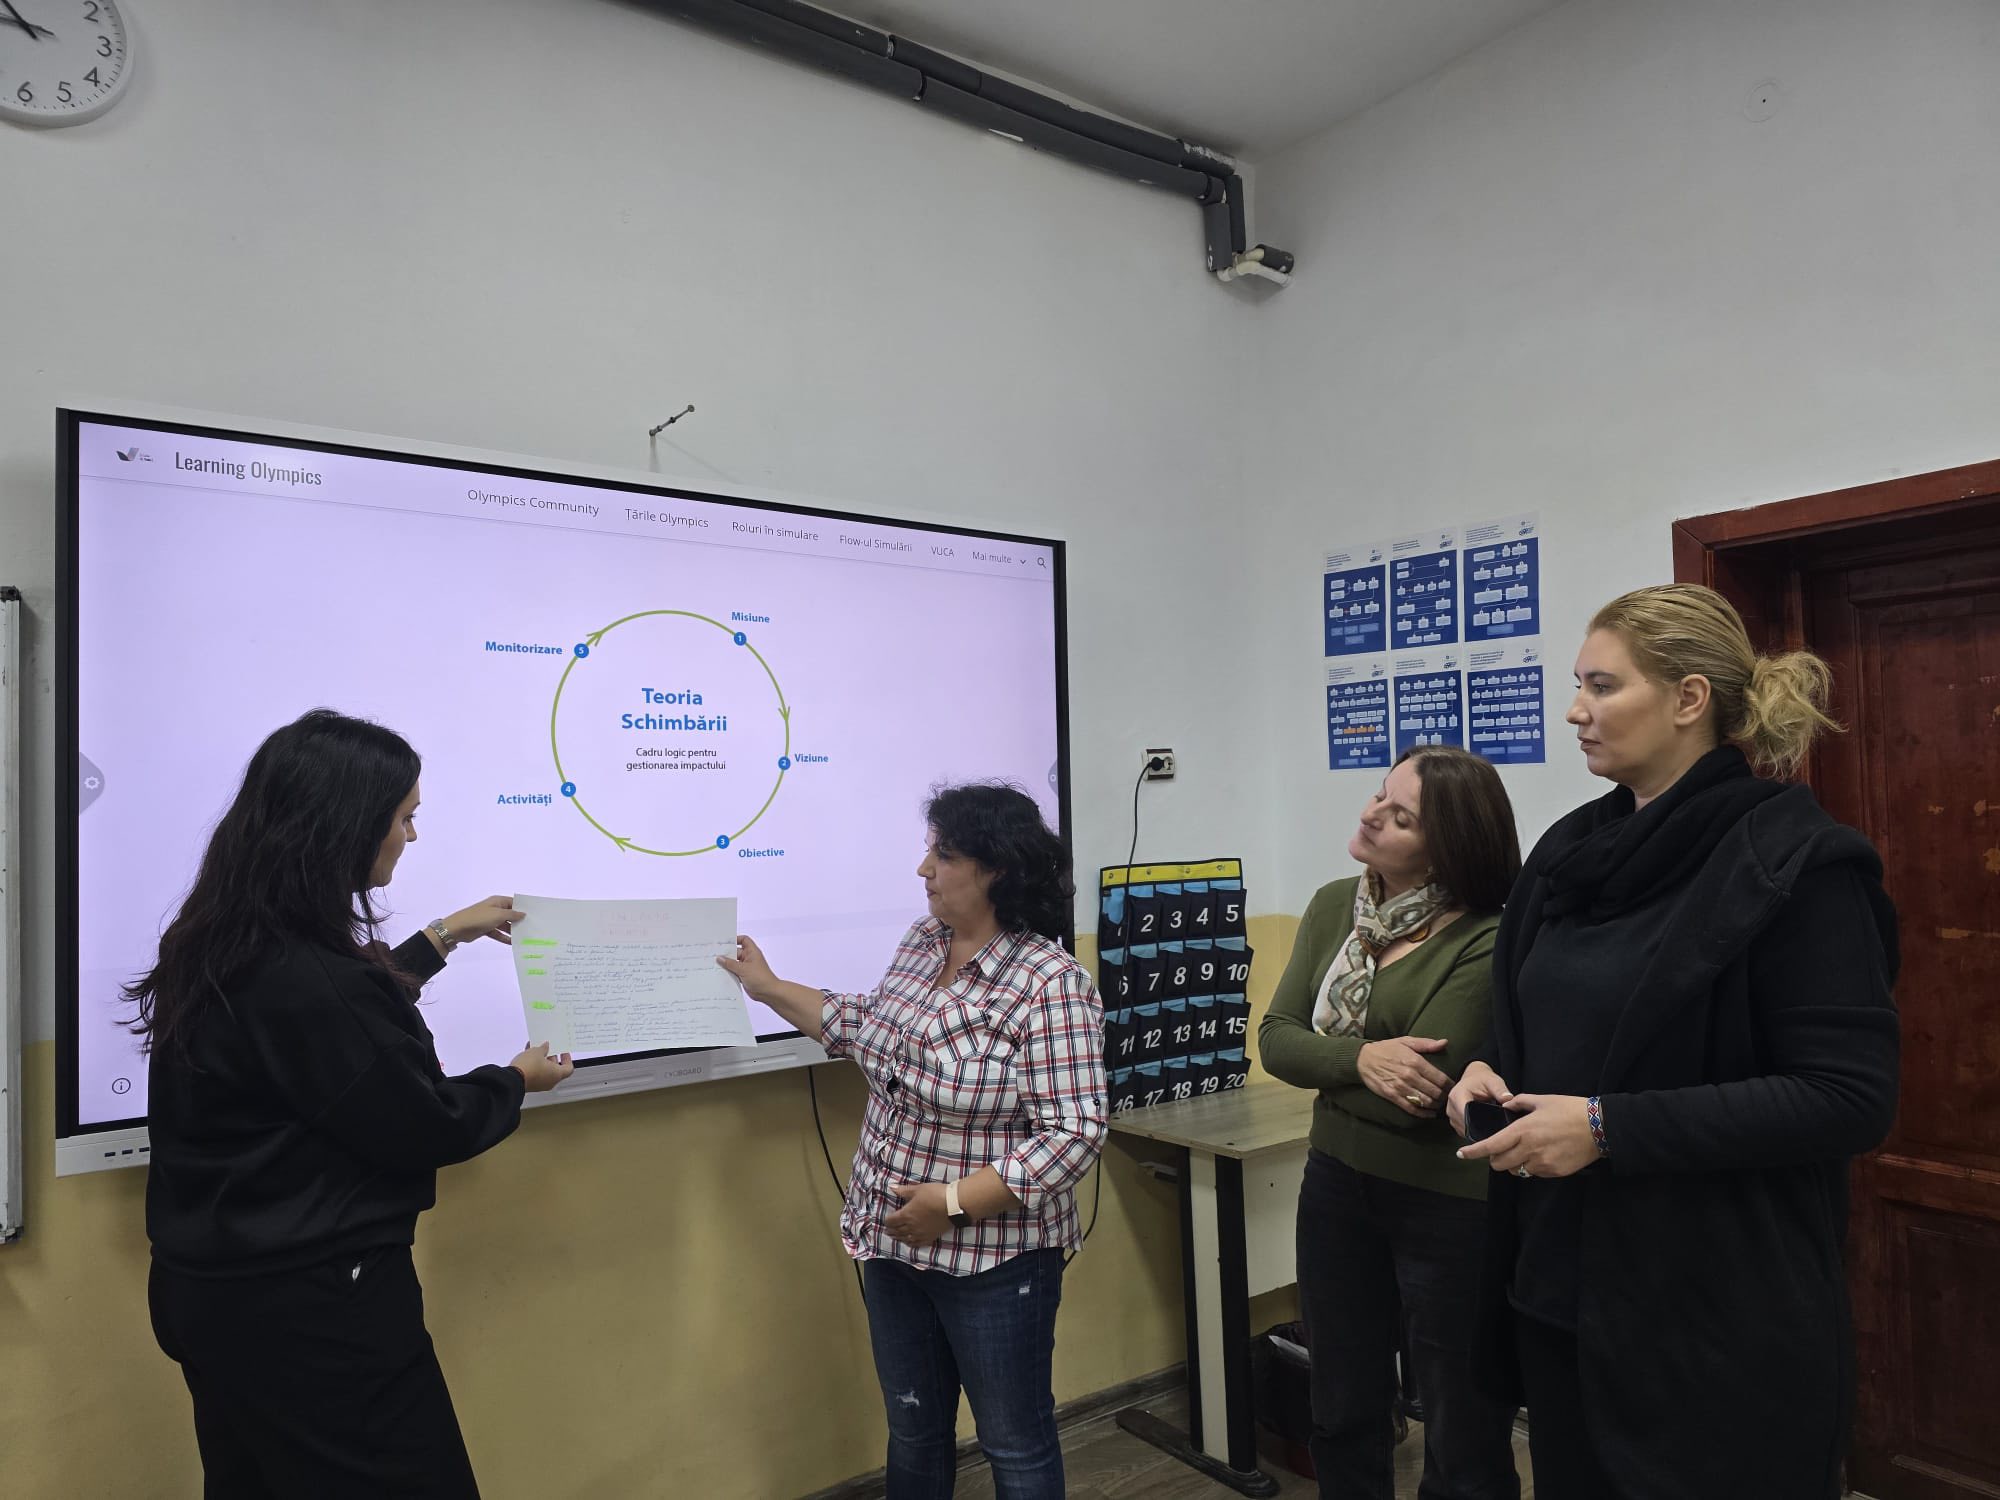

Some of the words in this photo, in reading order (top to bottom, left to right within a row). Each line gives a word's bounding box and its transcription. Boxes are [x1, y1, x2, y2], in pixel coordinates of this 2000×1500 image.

[83, 1, 99, 23] 2
[96, 36, 112, 57] 3
[83, 67, 100, 87] 4
[17, 81, 33, 102] 6
[56, 81, 72, 102] 5
[175, 452, 246, 479] Learning
[251, 461, 322, 486] Olympics
[467, 489, 526, 506] Olympics
[529, 497, 600, 517] Community
[659, 513, 709, 529] Olympics
[732, 521, 762, 535] Roluri
[765, 525, 774, 536] în
[776, 527, 819, 541] simulare
[839, 534, 872, 548] Flow-ul
[931, 546, 955, 557] VUCA
[972, 551, 987, 561] Mai
[989, 553, 1012, 564] multe
[731, 612, 770, 624] Misiune
[485, 641, 563, 655] Monitorizare
[642, 687, 703, 705] Teoria
[621, 713, 727, 731] Schimbării
[636, 747, 663, 757] Cadru
[665, 748, 686, 759] logic
[688, 749, 717, 759] pentru
[794, 753, 829, 763] Viziune
[626, 761, 679, 772] gestionarea
[680, 761, 726, 772] impactului
[738, 848, 785, 858] Obiective
[1141, 914, 1154, 932] 2
[1170, 911, 1182, 929] 3
[1196, 908, 1209, 926] 4
[1225, 904, 1239, 922] 5
[1148, 972, 1160, 991] 7
[1174, 967, 1187, 985] 8
[1200, 962, 1214, 980] 9
[1227, 964, 1248, 981] 10
[1120, 1035, 1135, 1056] 11
[1143, 1029, 1161, 1048] 12
[1173, 1024, 1191, 1043] 13
[1198, 1020, 1216, 1039] 14
[1225, 1017, 1247, 1035] 15
[1115, 1095, 1134, 1112] 16
[1144, 1089, 1164, 1107] 17
[1172, 1081, 1192, 1100] 18
[1200, 1076, 1219, 1094] 19
[1224, 1073, 1246, 1090] 20
